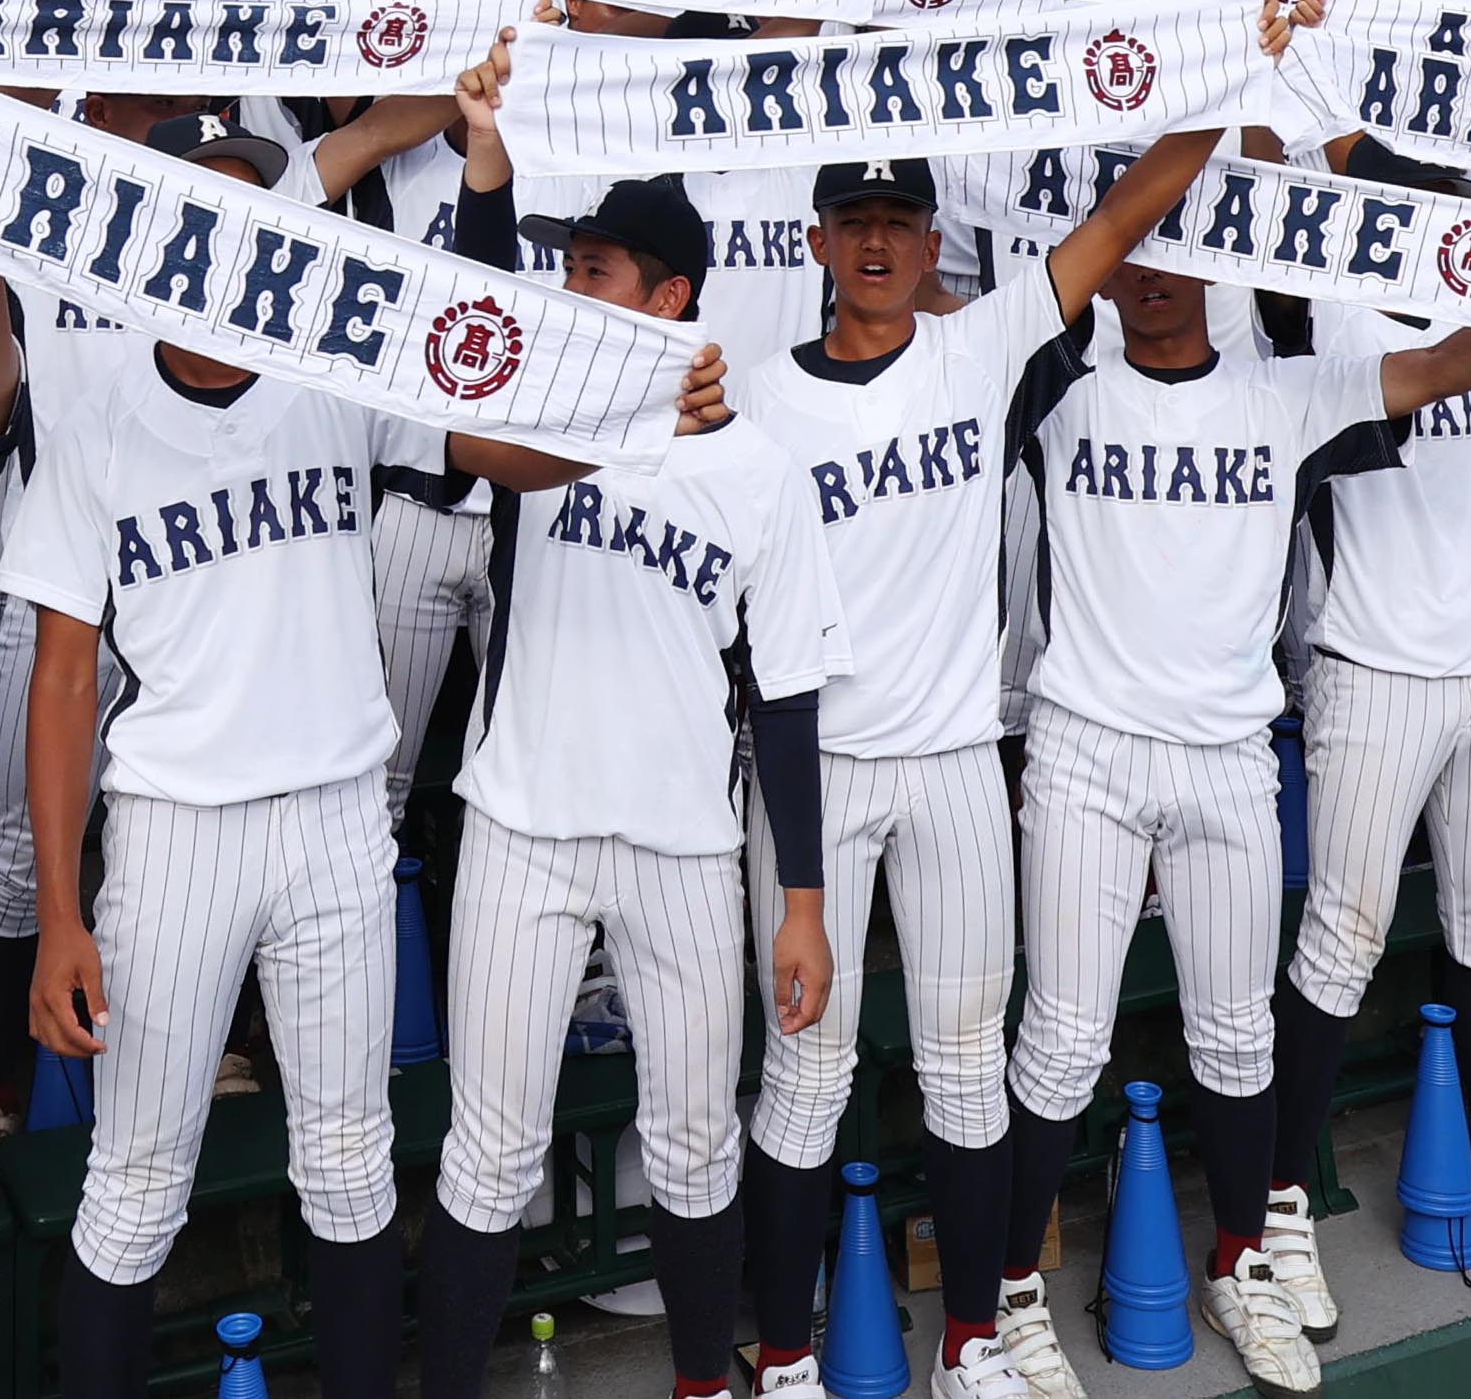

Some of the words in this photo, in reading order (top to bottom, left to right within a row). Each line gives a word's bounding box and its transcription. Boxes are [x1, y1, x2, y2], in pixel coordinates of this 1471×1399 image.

[199, 113, 228, 142] A
[672, 35, 1060, 137] ARIAKE
[1019, 148, 1419, 281] AAKE
[812, 418, 982, 523] RIAKE
[1065, 437, 1273, 504] ARIAKE
[118, 467, 358, 588] ARIAKE
